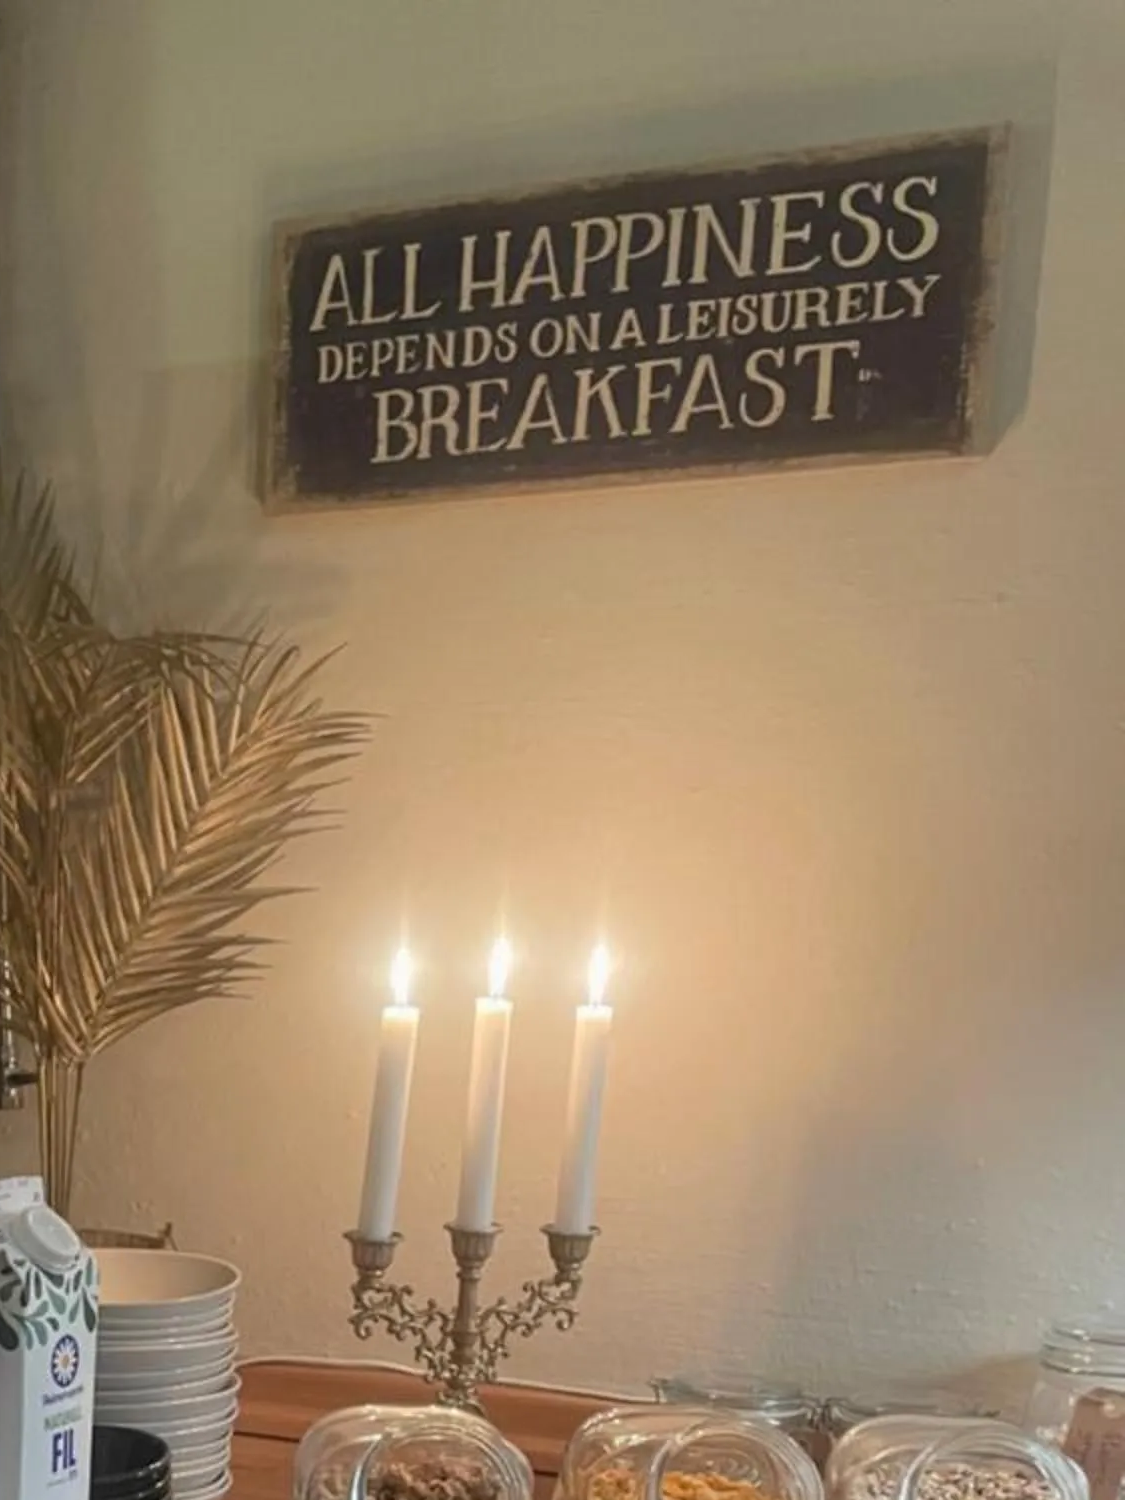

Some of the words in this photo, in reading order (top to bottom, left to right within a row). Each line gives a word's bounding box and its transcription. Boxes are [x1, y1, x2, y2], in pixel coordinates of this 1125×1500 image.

[310, 242, 441, 331] ALL
[459, 176, 941, 311] HAPPINESS
[317, 323, 516, 383] DEPENDS
[530, 311, 600, 357] ON
[611, 309, 645, 349] A
[656, 275, 941, 345] LEISURELY
[371, 340, 860, 462] BREAKFAST
[52, 1429, 77, 1473] FIL
